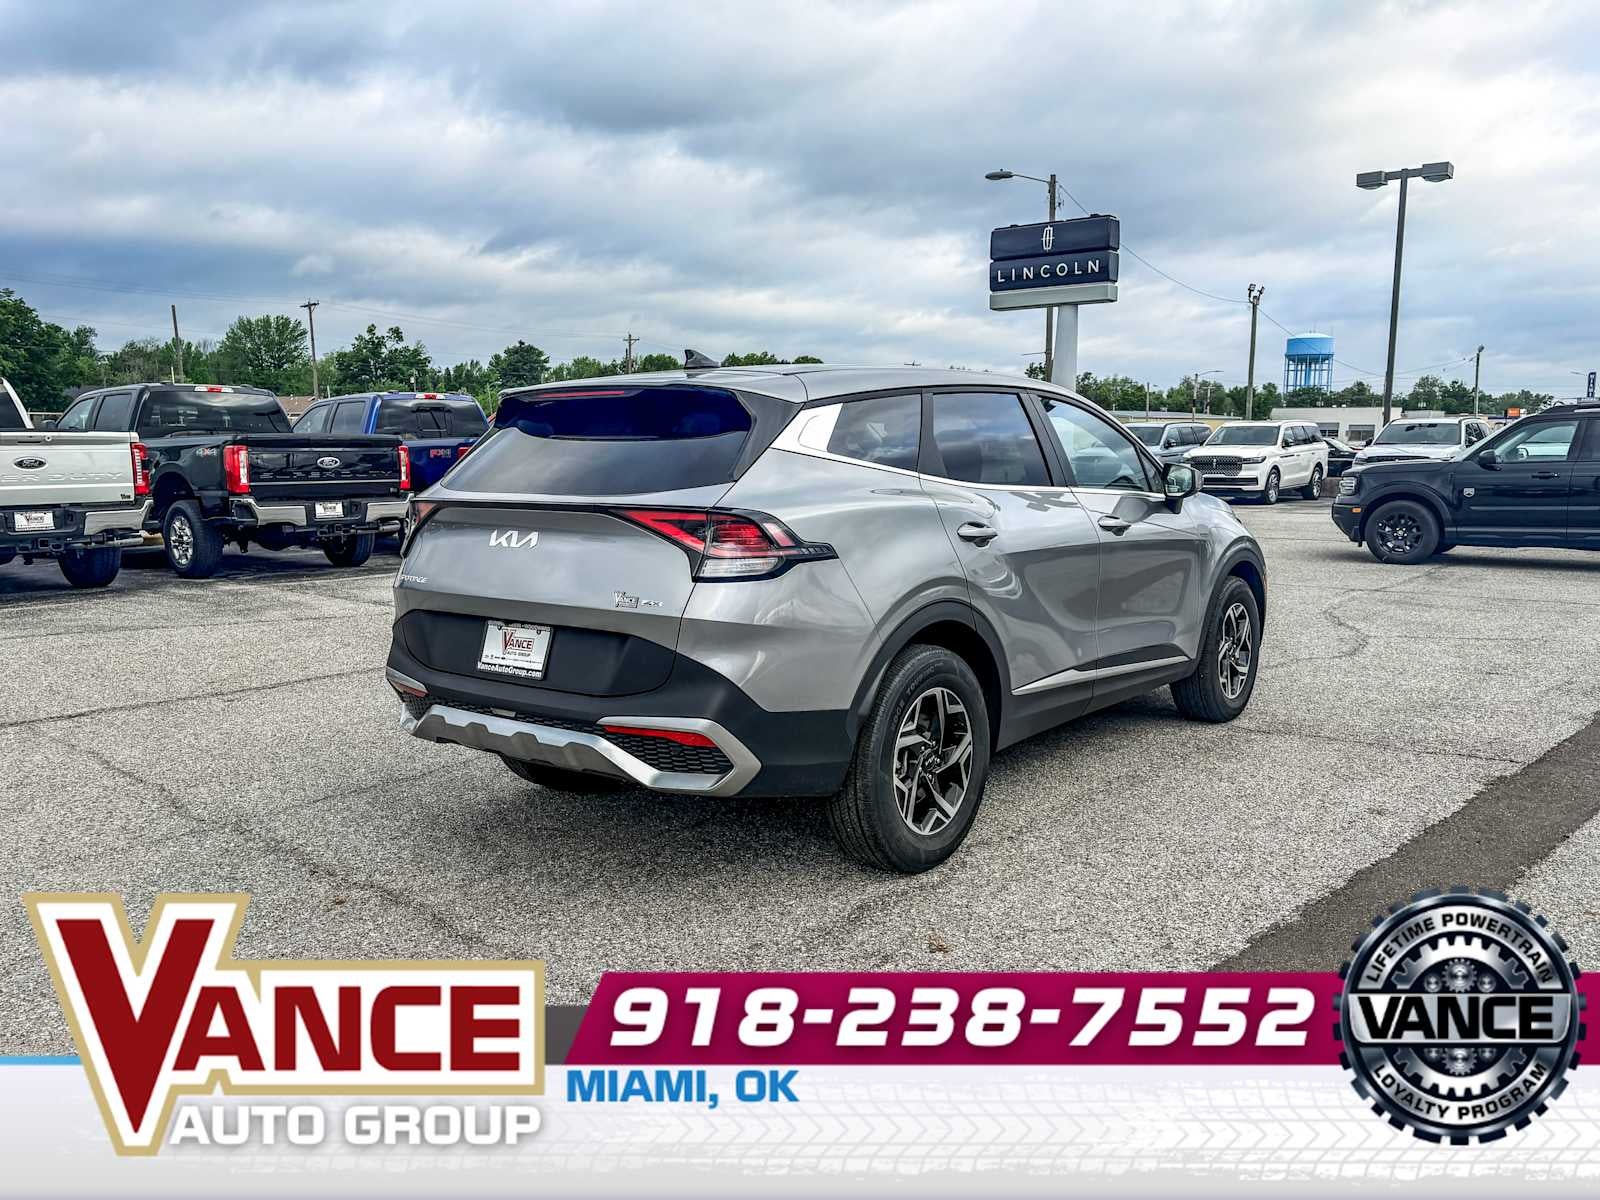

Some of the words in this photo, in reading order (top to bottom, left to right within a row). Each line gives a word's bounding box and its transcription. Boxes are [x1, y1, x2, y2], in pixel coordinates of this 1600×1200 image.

[997, 259, 1100, 283] LINCOLN
[488, 528, 539, 549] KIA
[503, 630, 533, 650] VANCE
[477, 660, 542, 678] VanceAutoGroup.com
